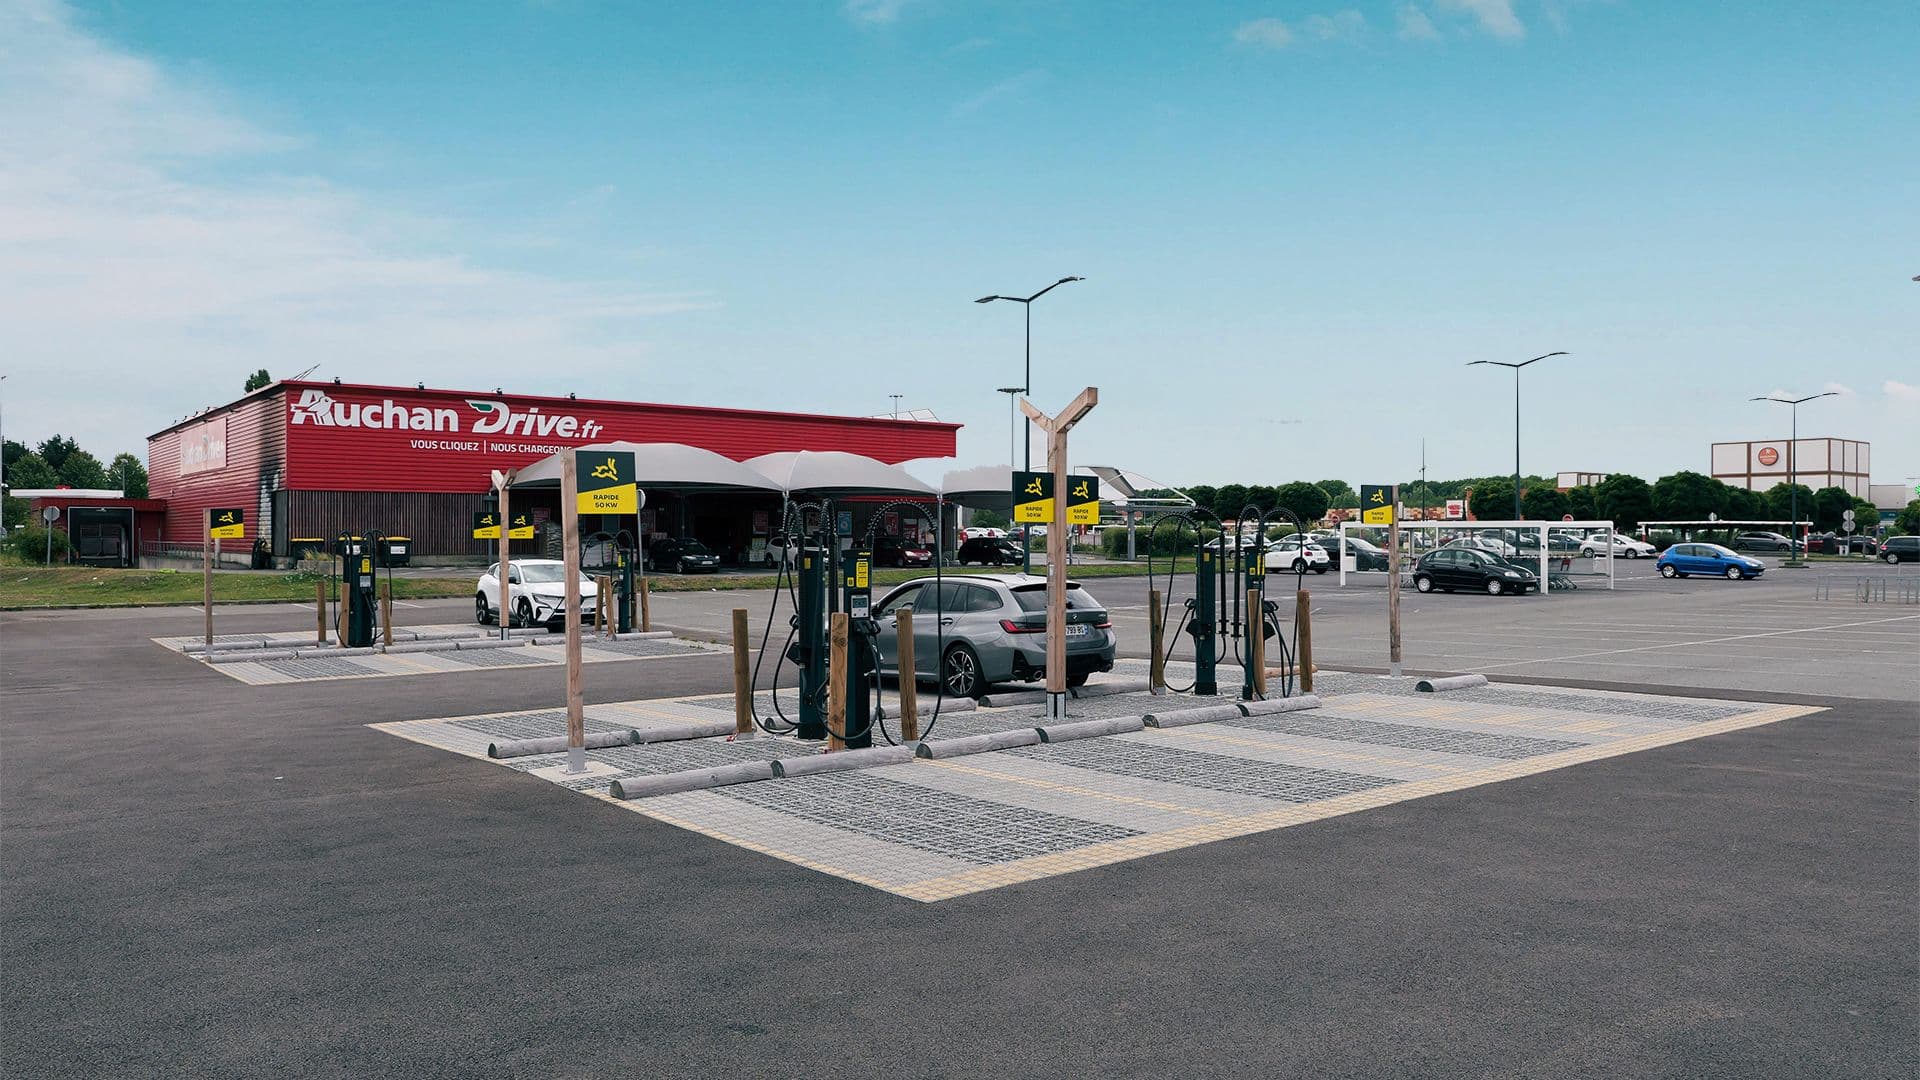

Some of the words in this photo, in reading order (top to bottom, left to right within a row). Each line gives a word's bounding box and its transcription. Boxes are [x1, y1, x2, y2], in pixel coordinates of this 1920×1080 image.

[290, 389, 459, 432] Auchan
[465, 400, 603, 438] Drive.fr
[411, 440, 437, 450] VOUS
[440, 440, 479, 451] CLIQUEZ
[491, 443, 516, 453] NOUS
